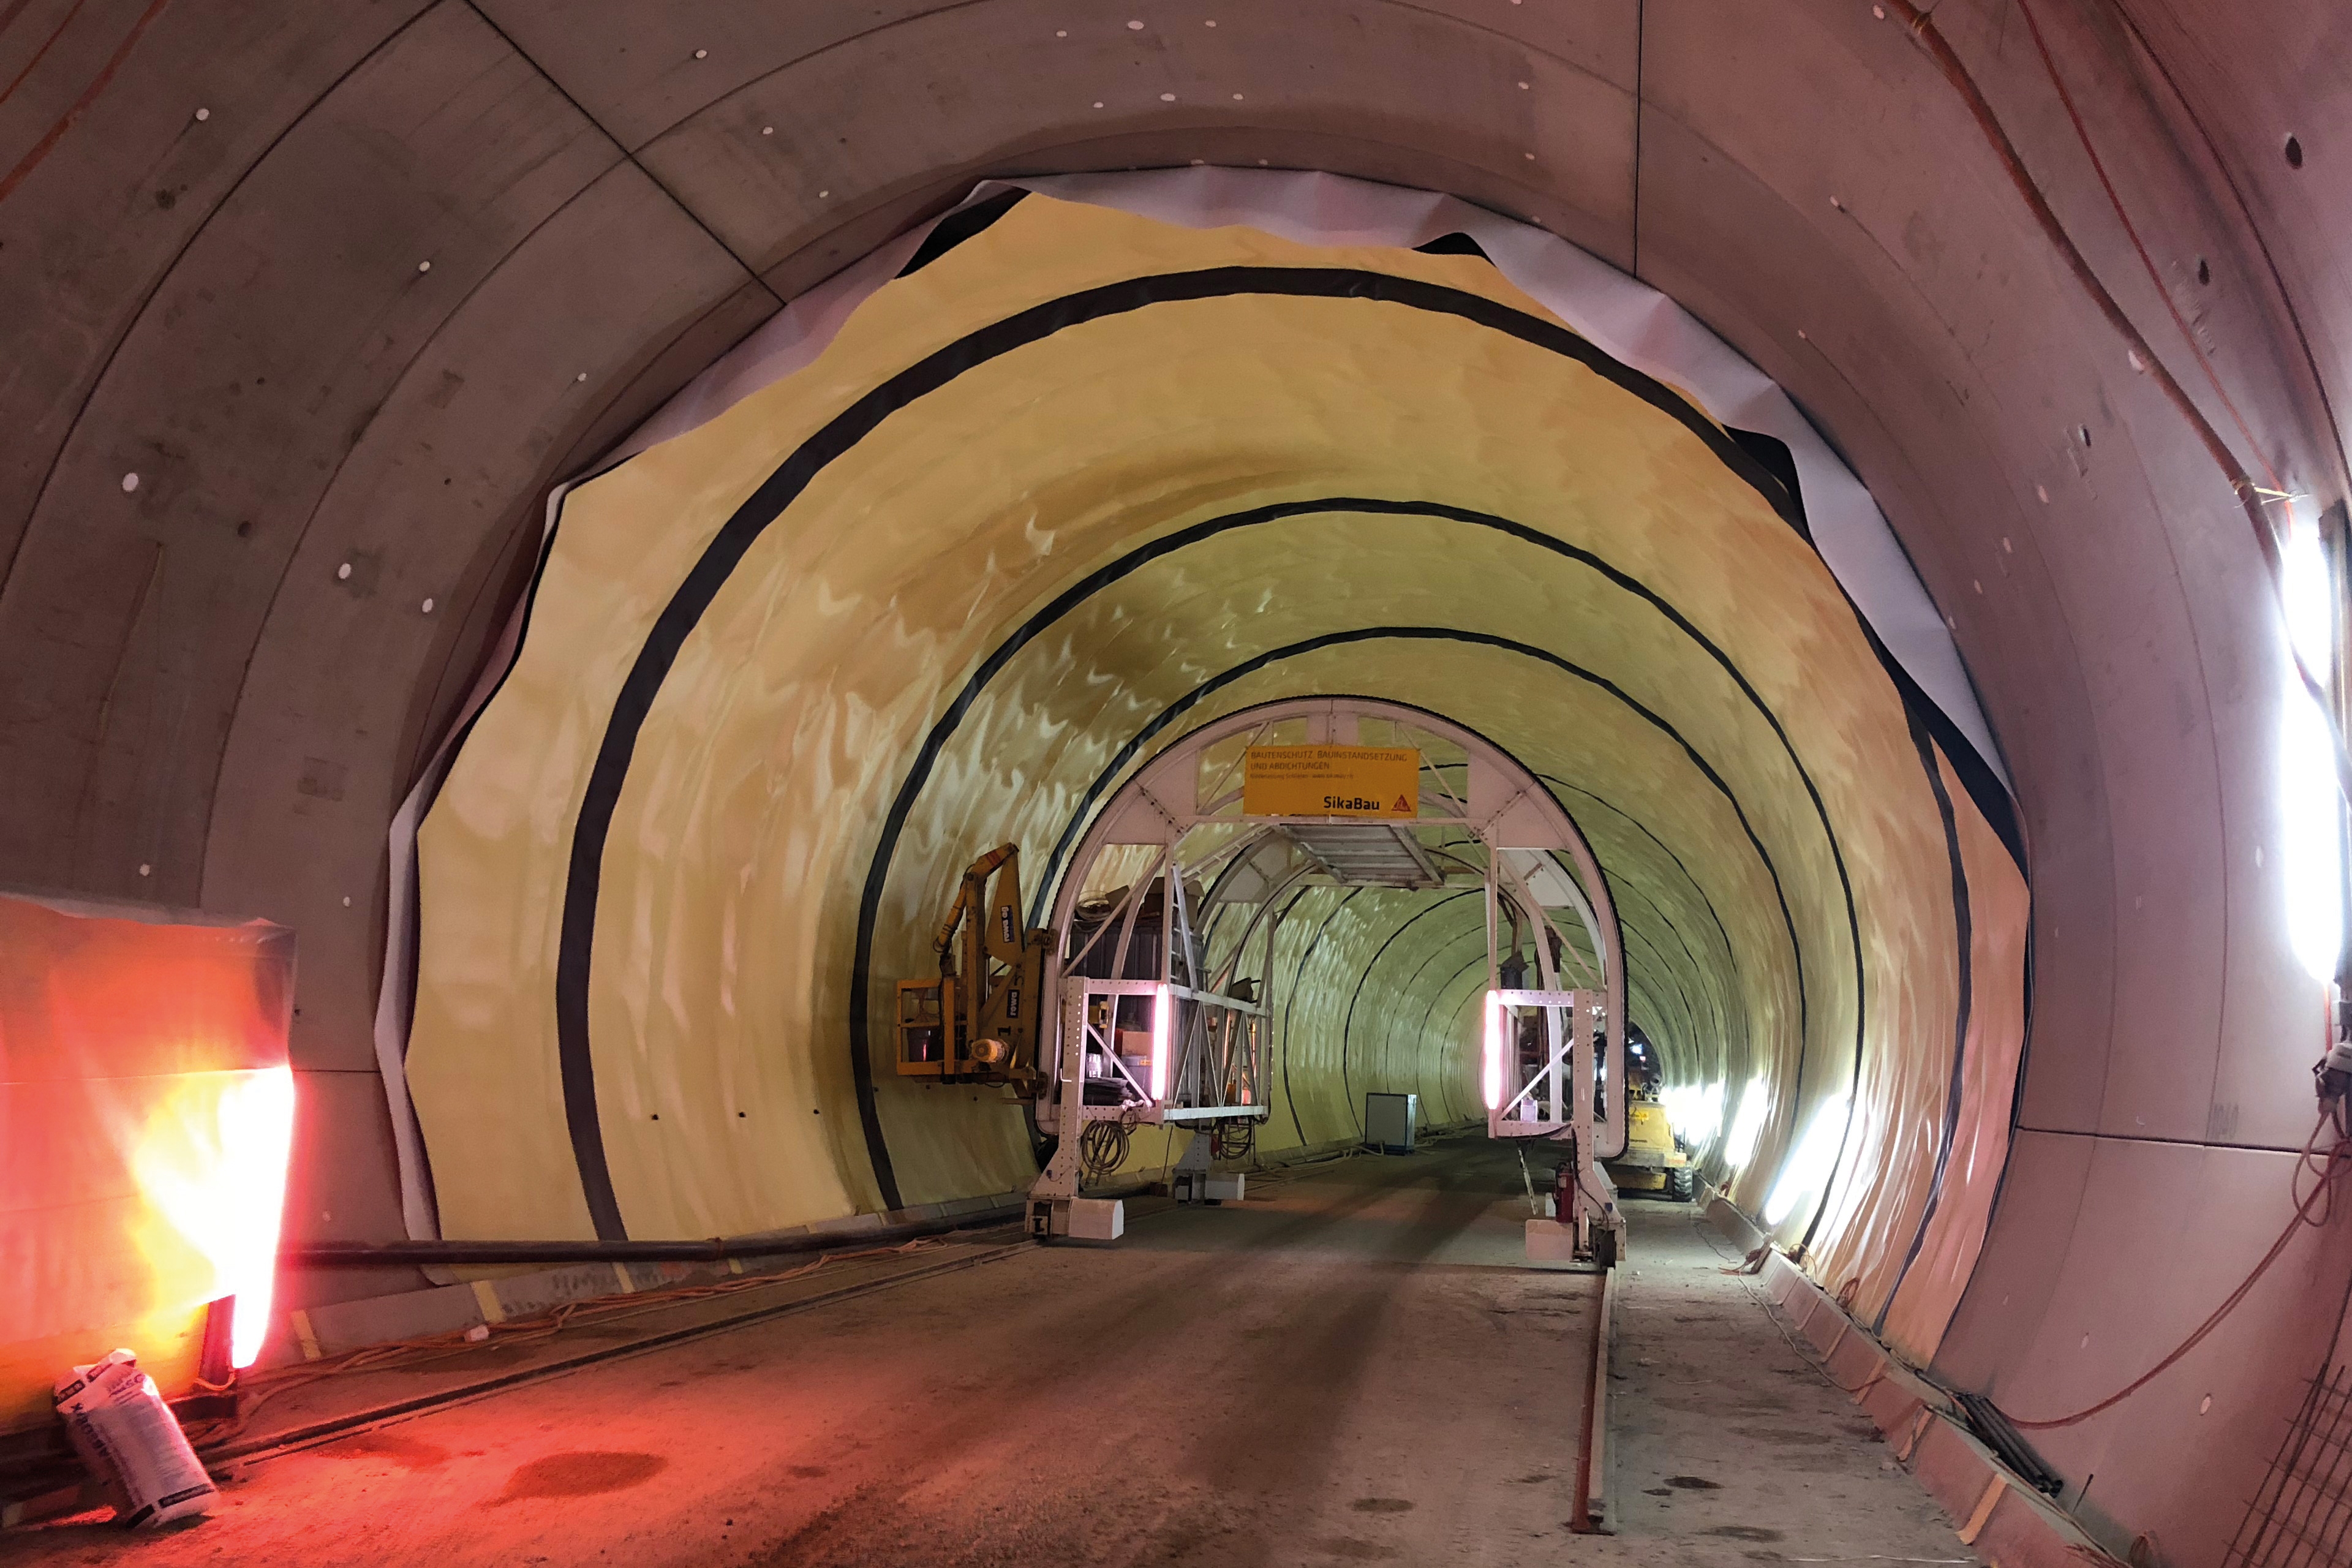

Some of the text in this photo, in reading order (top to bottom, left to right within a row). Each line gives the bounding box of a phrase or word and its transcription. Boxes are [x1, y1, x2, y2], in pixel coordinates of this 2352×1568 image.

[1251, 750, 1408, 761] BAUTENSCHUTZ BAUINSTANDSETZUNG
[1269, 761, 1330, 770] ABDICHTUNGEN
[1324, 796, 1380, 810] SikaBau
[1001, 907, 1009, 919] ag
